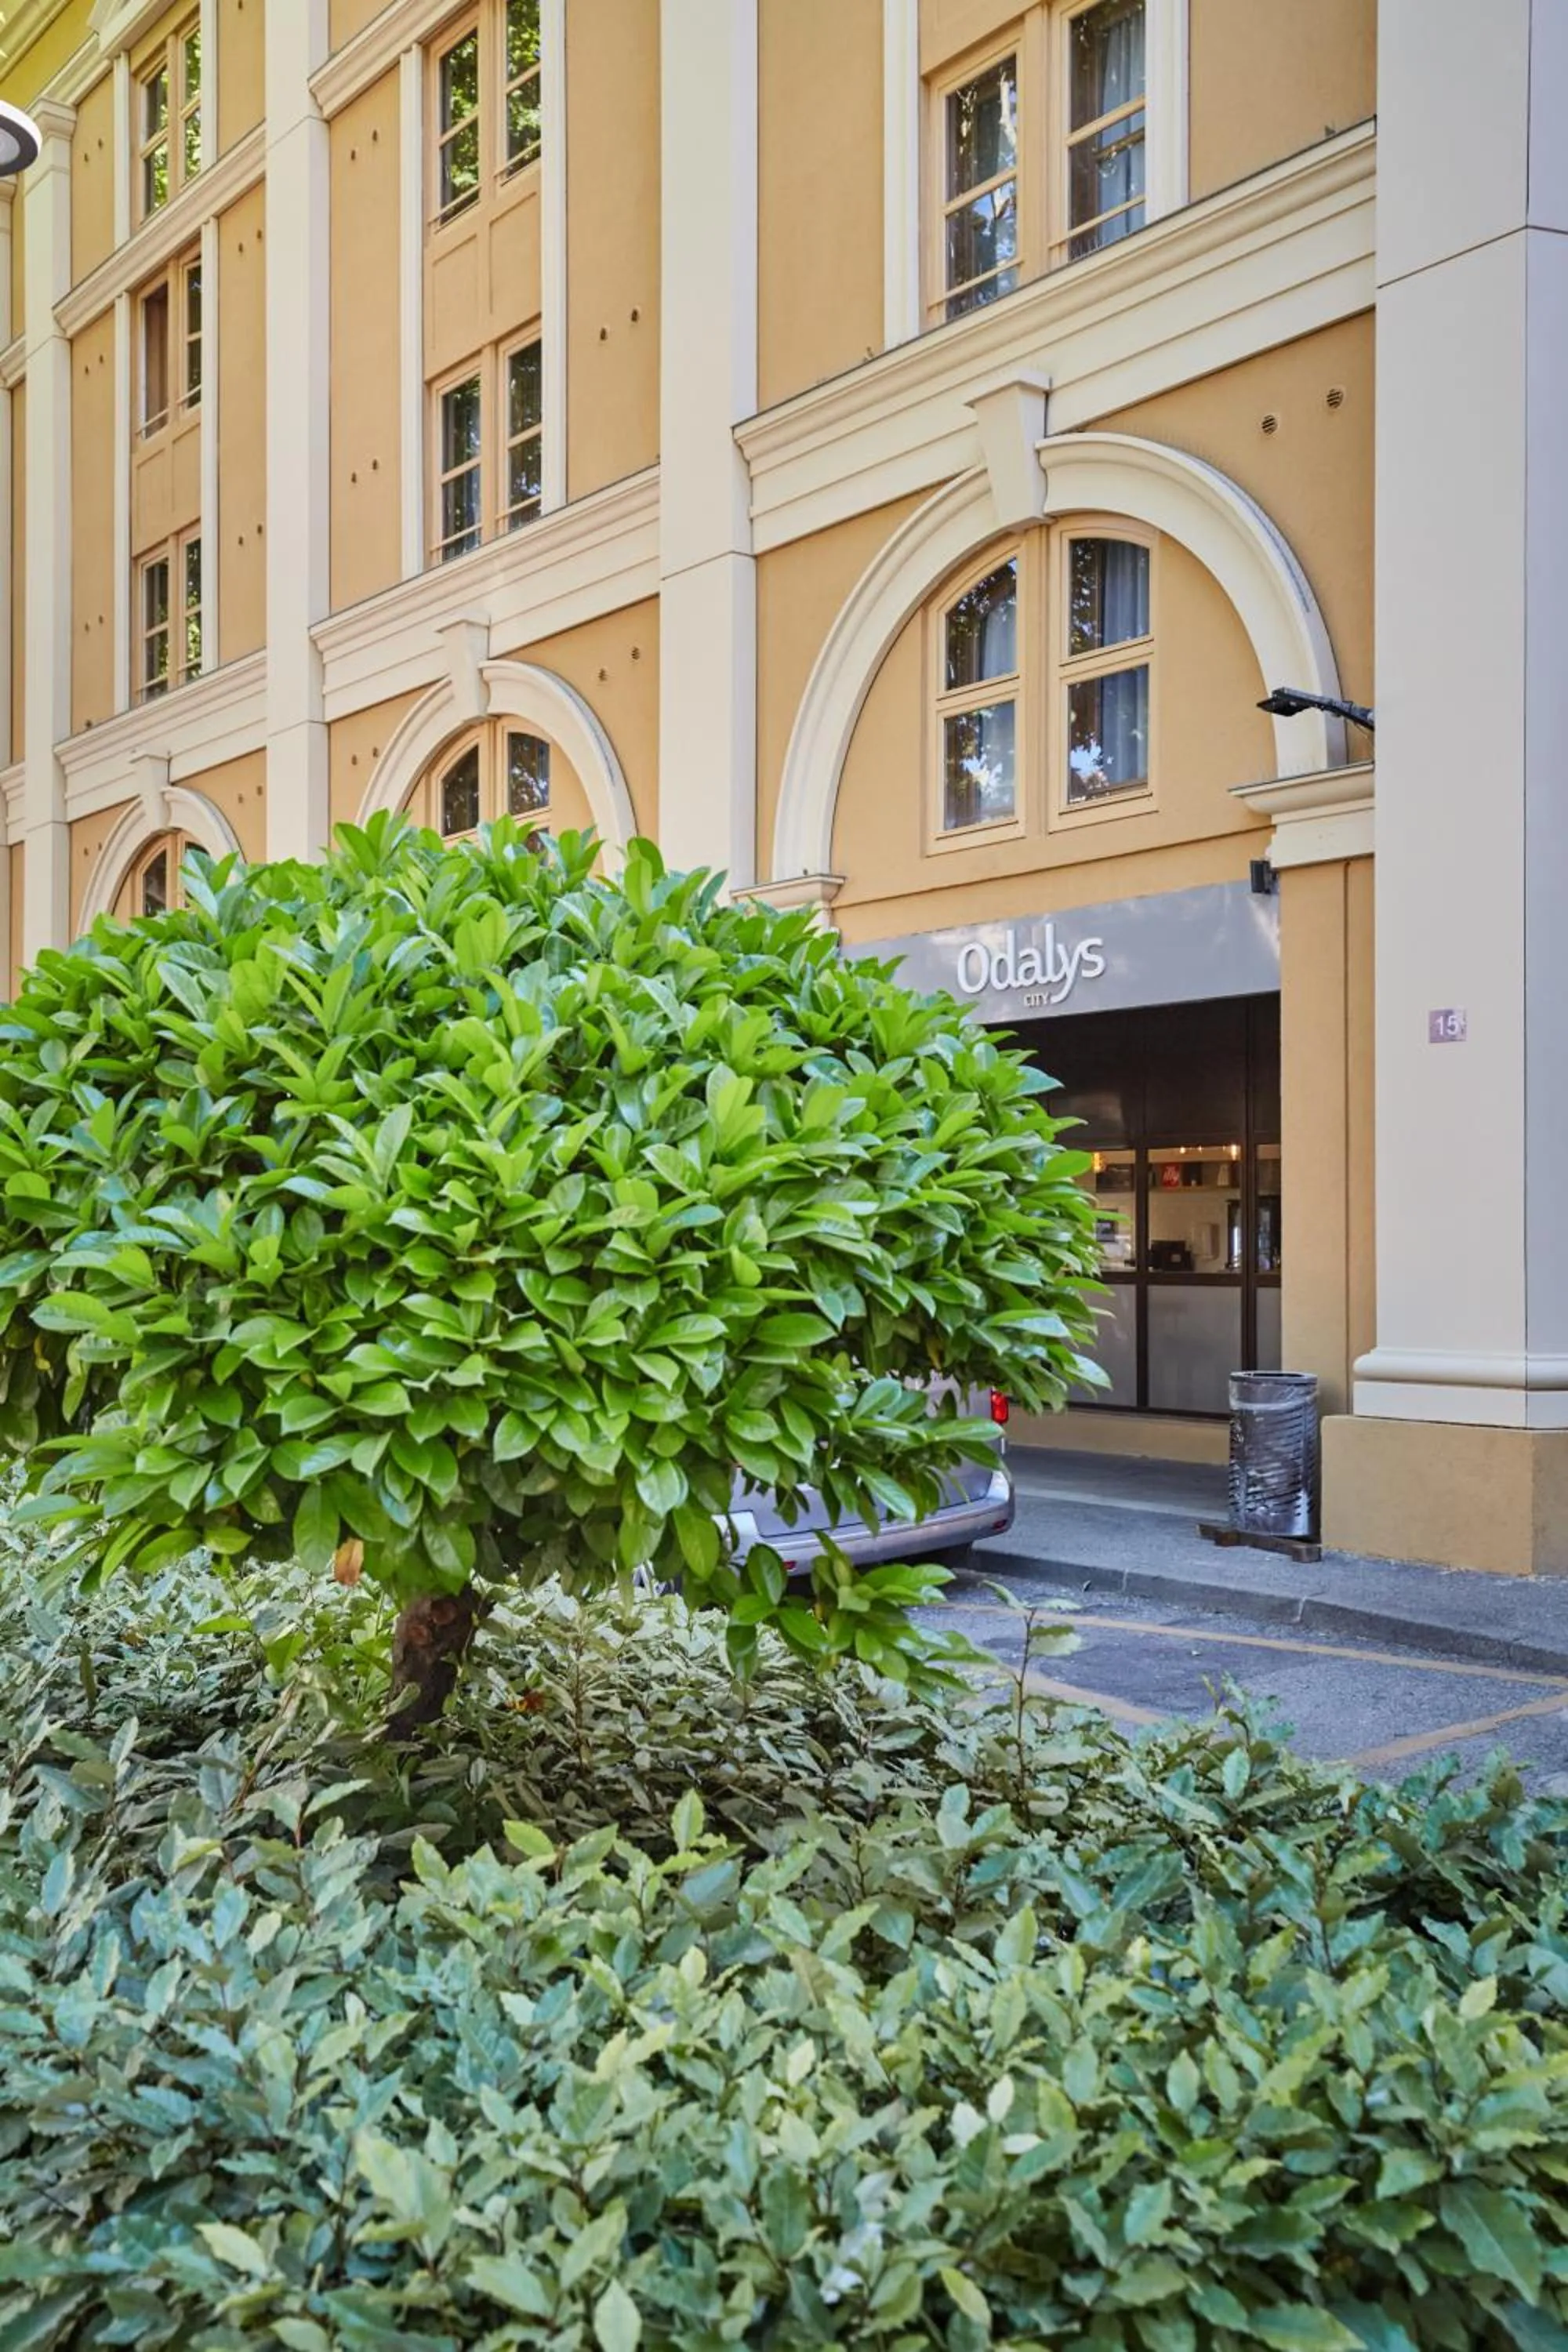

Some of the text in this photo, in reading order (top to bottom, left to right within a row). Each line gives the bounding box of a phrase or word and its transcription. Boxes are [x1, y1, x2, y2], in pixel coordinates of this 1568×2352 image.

[957, 924, 1105, 1004] Odalys
[1024, 993, 1049, 1007] CITY
[1436, 1015, 1459, 1036] 15
